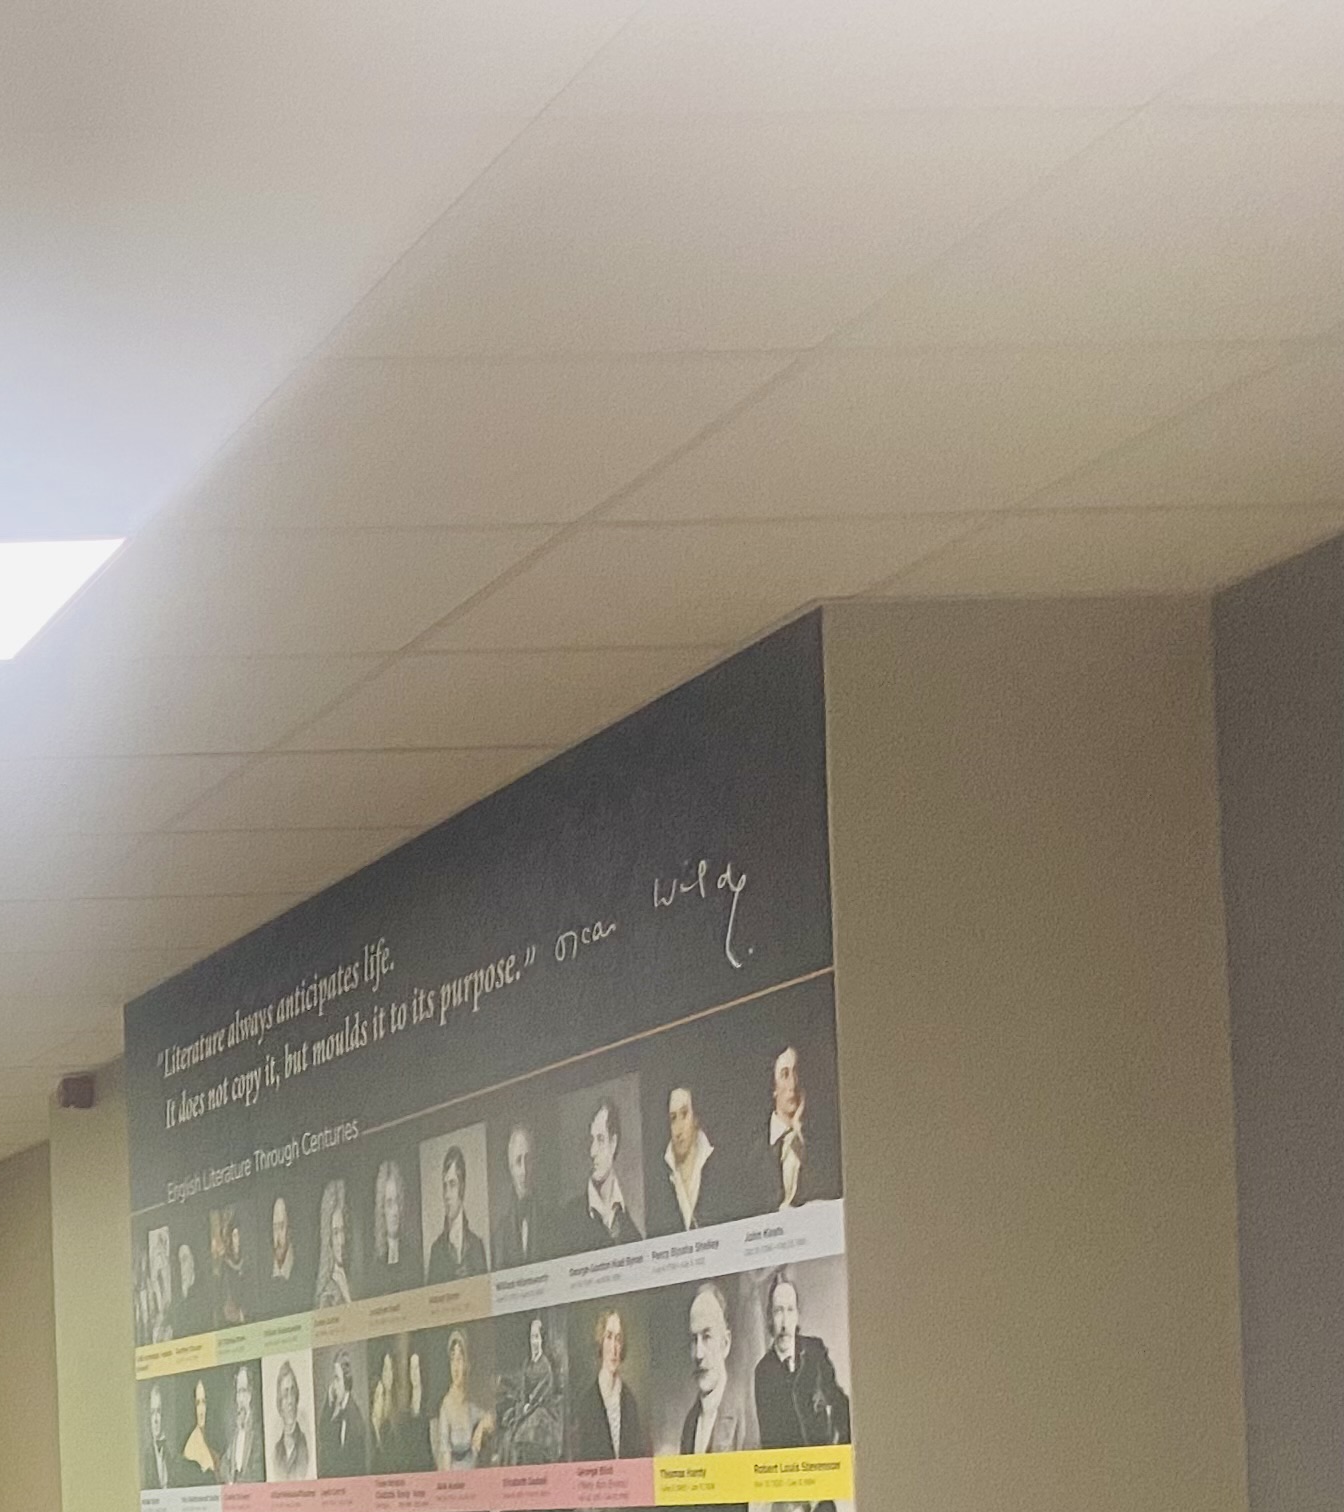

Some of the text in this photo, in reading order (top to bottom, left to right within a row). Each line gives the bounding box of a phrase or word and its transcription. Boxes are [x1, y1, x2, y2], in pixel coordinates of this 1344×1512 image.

[228, 1009, 274, 1045] always
[276, 960, 359, 1025] anticipates
[363, 937, 395, 992] life.
[165, 1099, 177, 1129] It
[178, 1089, 206, 1124] does
[208, 1076, 229, 1110] not
[231, 1065, 261, 1107] copy
[264, 1054, 281, 1091] it,
[284, 1041, 309, 1079] but
[312, 1011, 369, 1066] moulds
[372, 1005, 387, 1041] it
[390, 1002, 407, 1034] to
[412, 987, 436, 1025] its
[167, 1119, 359, 1204] English Literature Through Centuries
[753, 1461, 841, 1474] Robert Louis Stevenson
